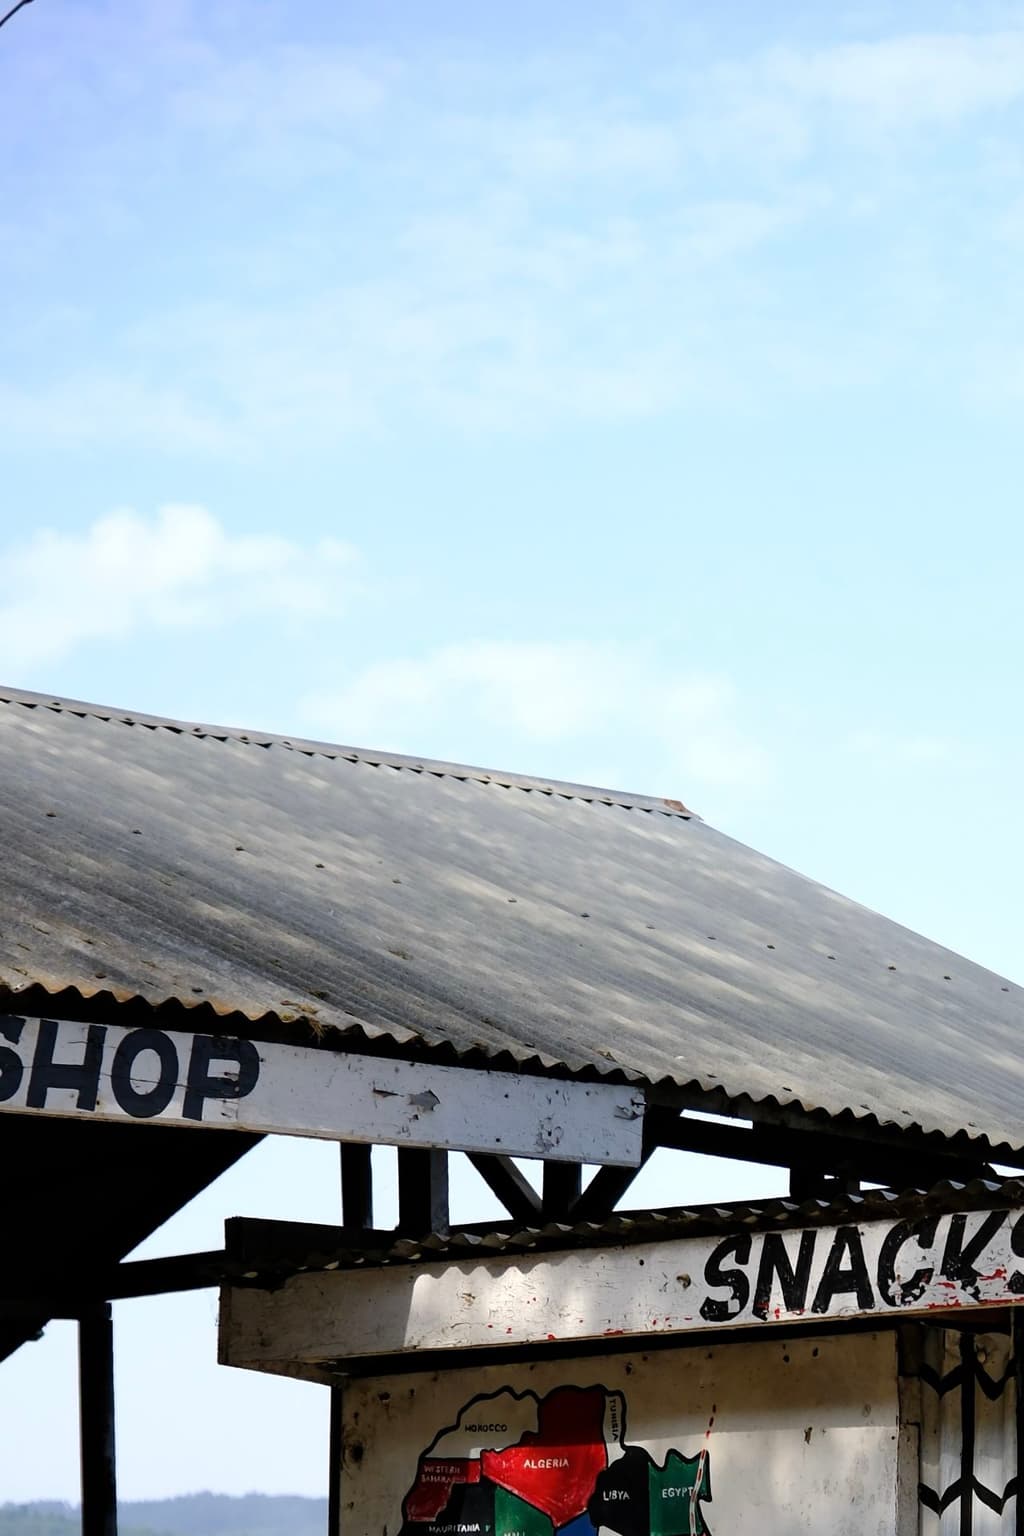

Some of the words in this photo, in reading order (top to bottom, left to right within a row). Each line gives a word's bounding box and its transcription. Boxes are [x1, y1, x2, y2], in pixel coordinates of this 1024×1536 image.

[523, 1458, 570, 1469] ALGERIA
[602, 1489, 631, 1501] LIBYA
[661, 1486, 694, 1499] EGYPT
[428, 1522, 481, 1534] MAURITANIA
